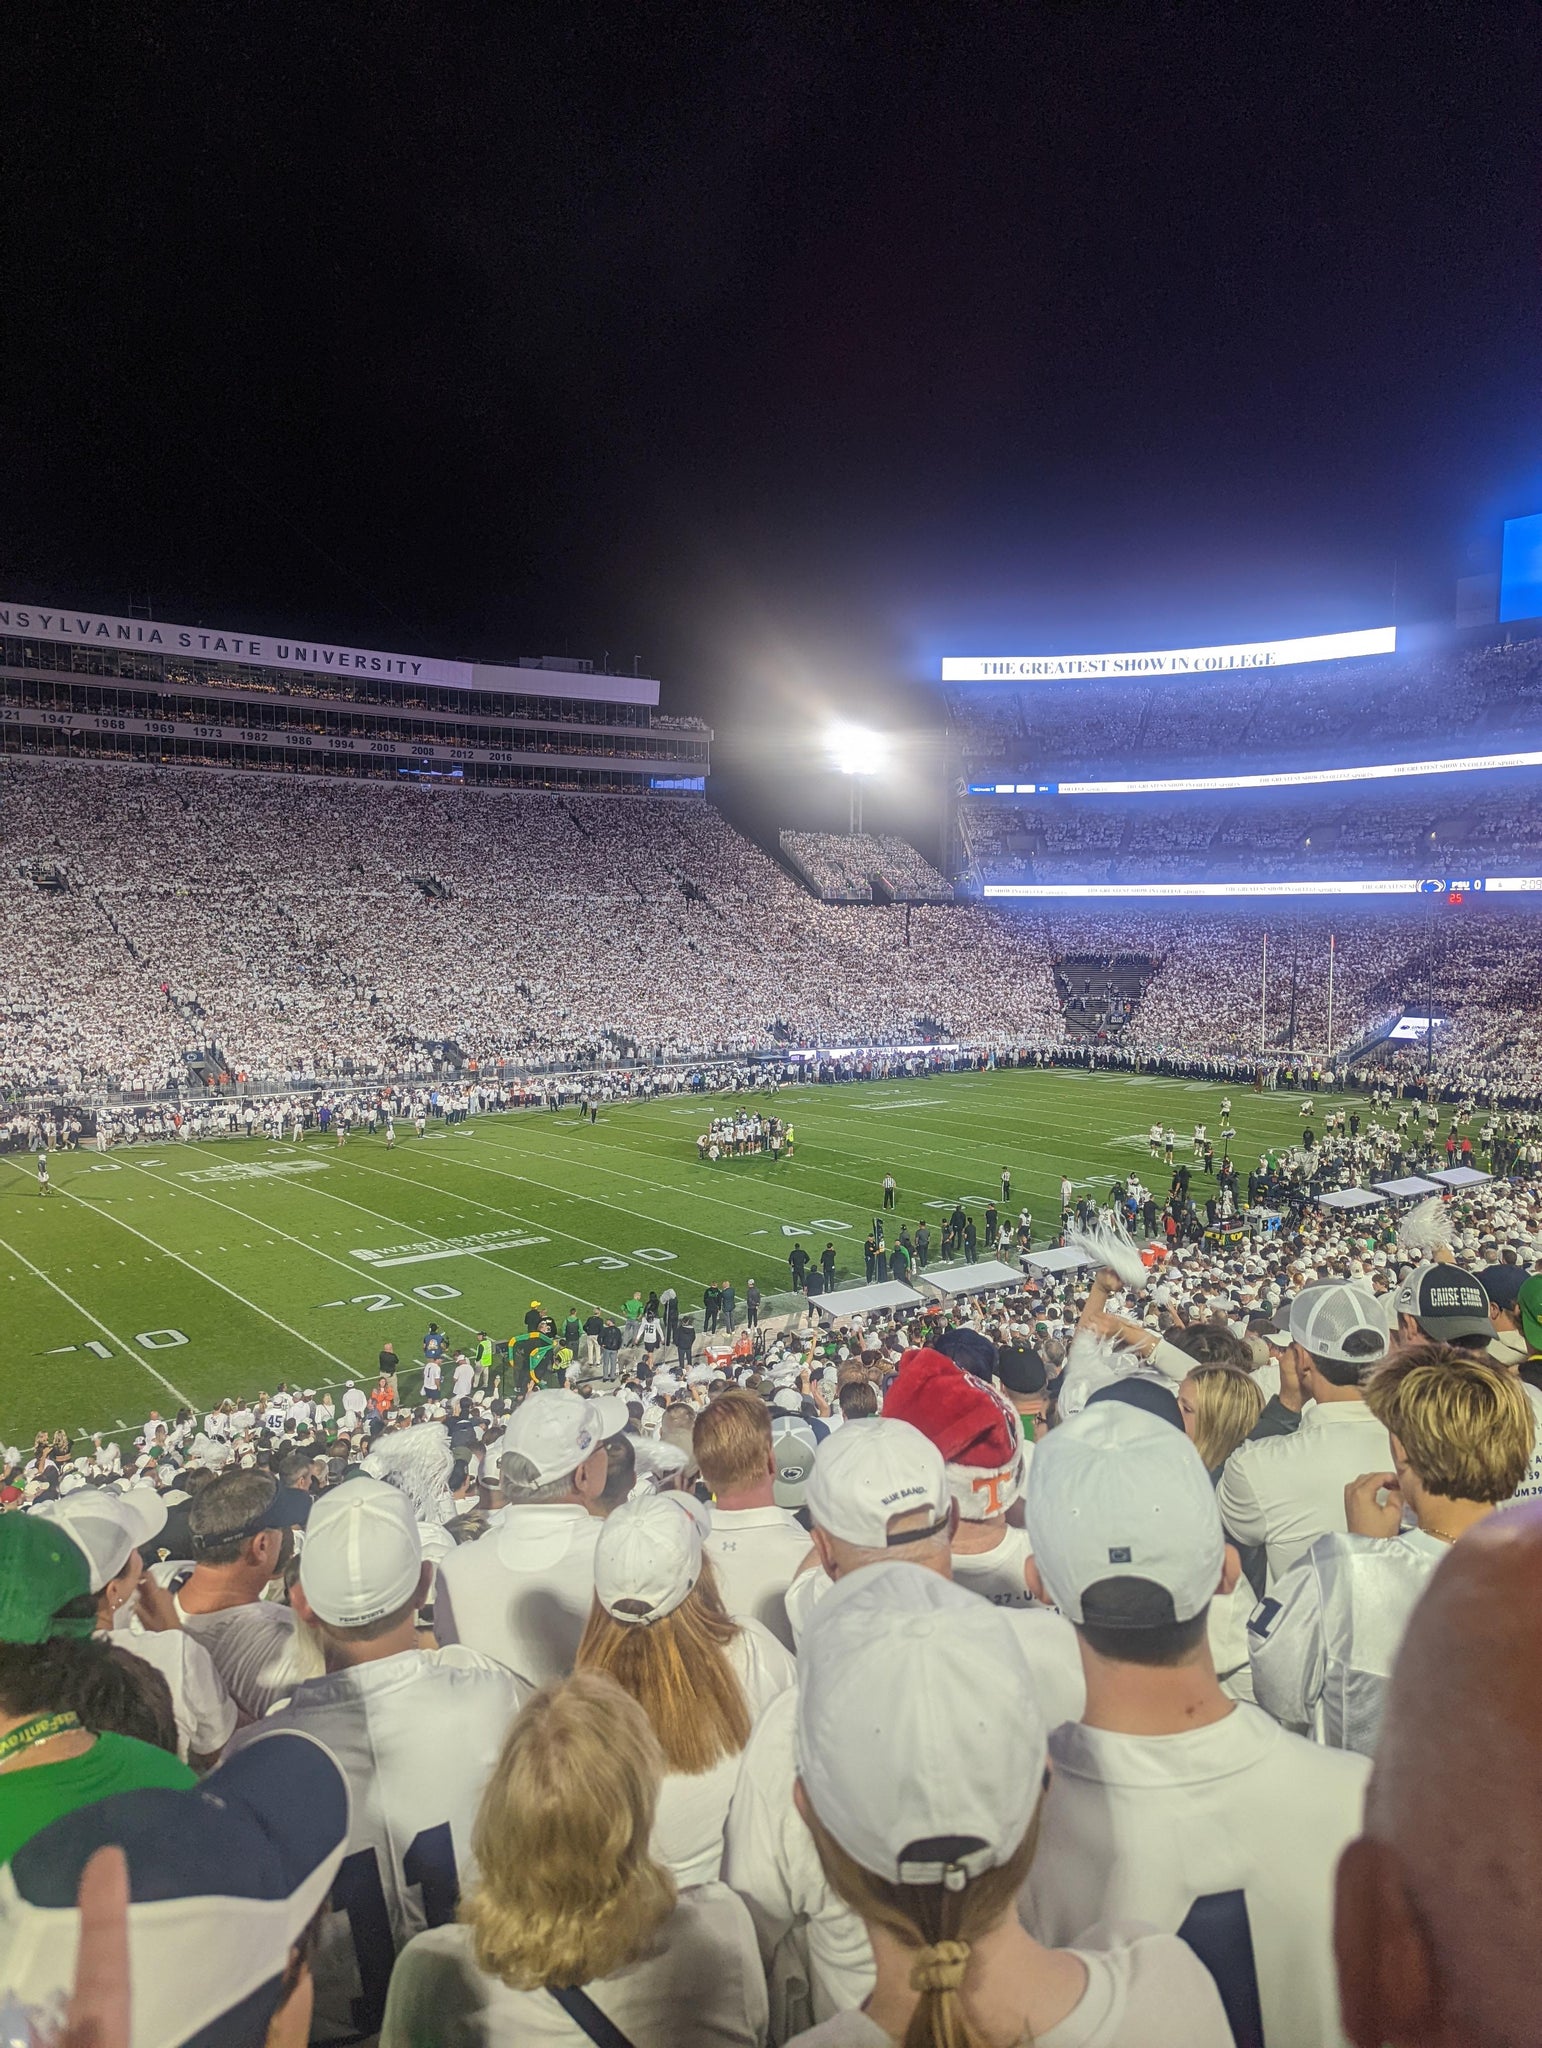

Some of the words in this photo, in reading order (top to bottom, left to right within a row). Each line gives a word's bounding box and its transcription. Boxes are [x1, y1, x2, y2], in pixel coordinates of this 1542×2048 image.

[0, 610, 163, 644] NSYLVANIA
[179, 633, 261, 656] STATE
[277, 645, 423, 676] UNIVERSITY
[981, 662, 1016, 674] THE
[1020, 660, 1110, 675] GREATEST
[1113, 657, 1167, 672] SHOW
[1171, 656, 1190, 670] IN
[1194, 652, 1276, 671] COLLEGE
[40, 713, 73, 725] 1947
[94, 718, 126, 730] 1968
[145, 722, 175, 734] 1969
[193, 726, 223, 738] 1973
[239, 730, 268, 742] 1982
[285, 735, 312, 747] 1986
[328, 739, 354, 750] 1994
[370, 742, 396, 753] 2005
[411, 746, 434, 757] 2008
[450, 750, 474, 760] 2012
[489, 752, 513, 762] 2016
[1449, 893, 1462, 903] 25
[780, 1218, 854, 1237] 40
[373, 1241, 438, 1254] WEST
[447, 1228, 528, 1245] SHORE
[582, 1247, 679, 1270] 30
[350, 1283, 464, 1313] 20
[1430, 1286, 1460, 1307] CAUSE
[84, 1328, 191, 1359] 10
[267, 1415, 282, 1428] 45
[1528, 1471, 1540, 1480] 59
[881, 1492, 900, 1505] BLUE
[971, 1471, 1012, 1516] T
[1246, 1597, 1283, 1639] 1
